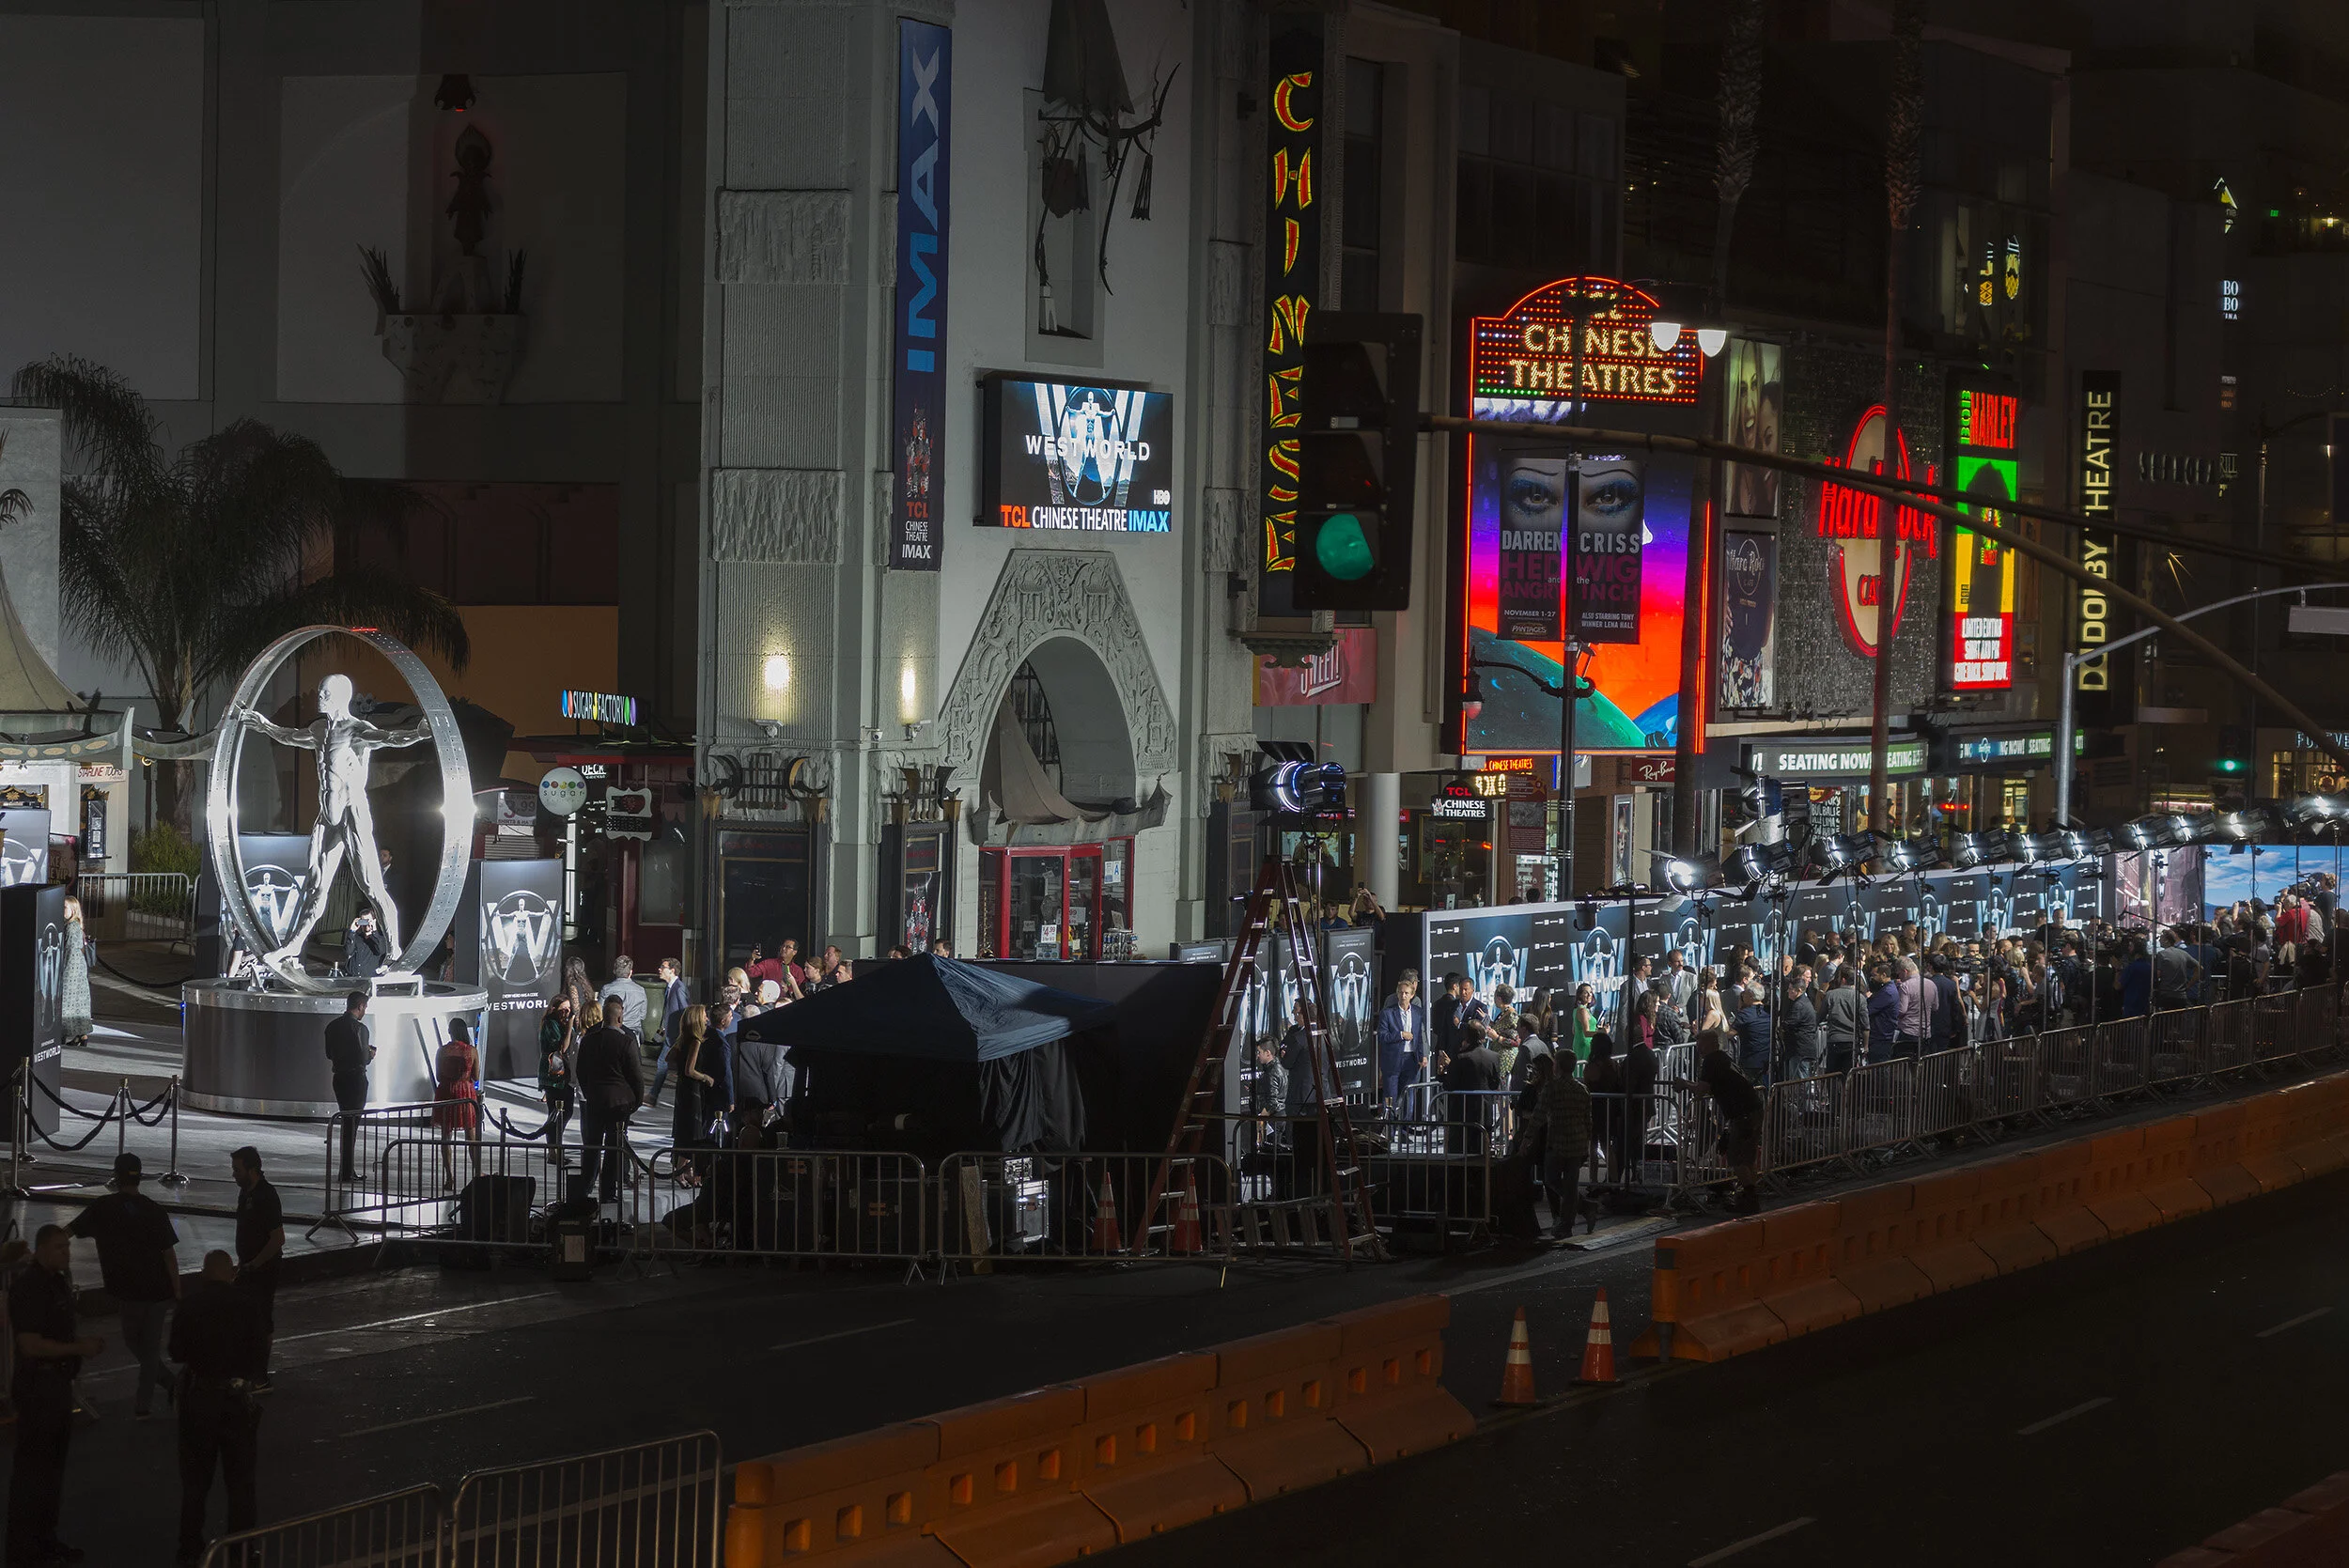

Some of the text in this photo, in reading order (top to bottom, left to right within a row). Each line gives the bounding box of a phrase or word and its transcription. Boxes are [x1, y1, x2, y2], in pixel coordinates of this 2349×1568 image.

[907, 46, 940, 373] IMAX
[2223, 280, 2239, 296] BO
[2223, 297, 2239, 312] BO
[1267, 71, 1314, 573] CHINESE
[1524, 323, 1663, 359] CHNES
[1509, 359, 1677, 395] THEATRES
[1969, 391, 2017, 449] MARLEY
[1026, 435, 1151, 461] WESTWORLD
[2084, 390, 2113, 532] HEATRE
[1153, 489, 1171, 505] HBO
[907, 502, 928, 518] TCL
[1001, 505, 1171, 532] TCL CHINESE THEATRE IMAX
[1894, 464, 1939, 560] ock
[905, 520, 928, 532] CHINESE
[905, 531, 928, 542] THEATRE
[1501, 530, 1562, 551] DARREN
[1579, 532, 1640, 553] CRISS
[902, 544, 932, 559] IMAX
[1577, 576, 1590, 584] the
[1859, 575, 1881, 606] CA
[573, 691, 625, 724] SUGAR FACTORY
[1779, 753, 1838, 772] SEATING
[1887, 750, 1912, 768] EATING
[542, 789, 583, 799] sugar
[1446, 786, 1472, 797] TCL
[1444, 809, 1486, 818] THEATRES
[1445, 800, 1486, 810] CHINESE
[484, 998, 550, 1012] WESTWORL
[34, 1045, 61, 1063] WESTWORLD
